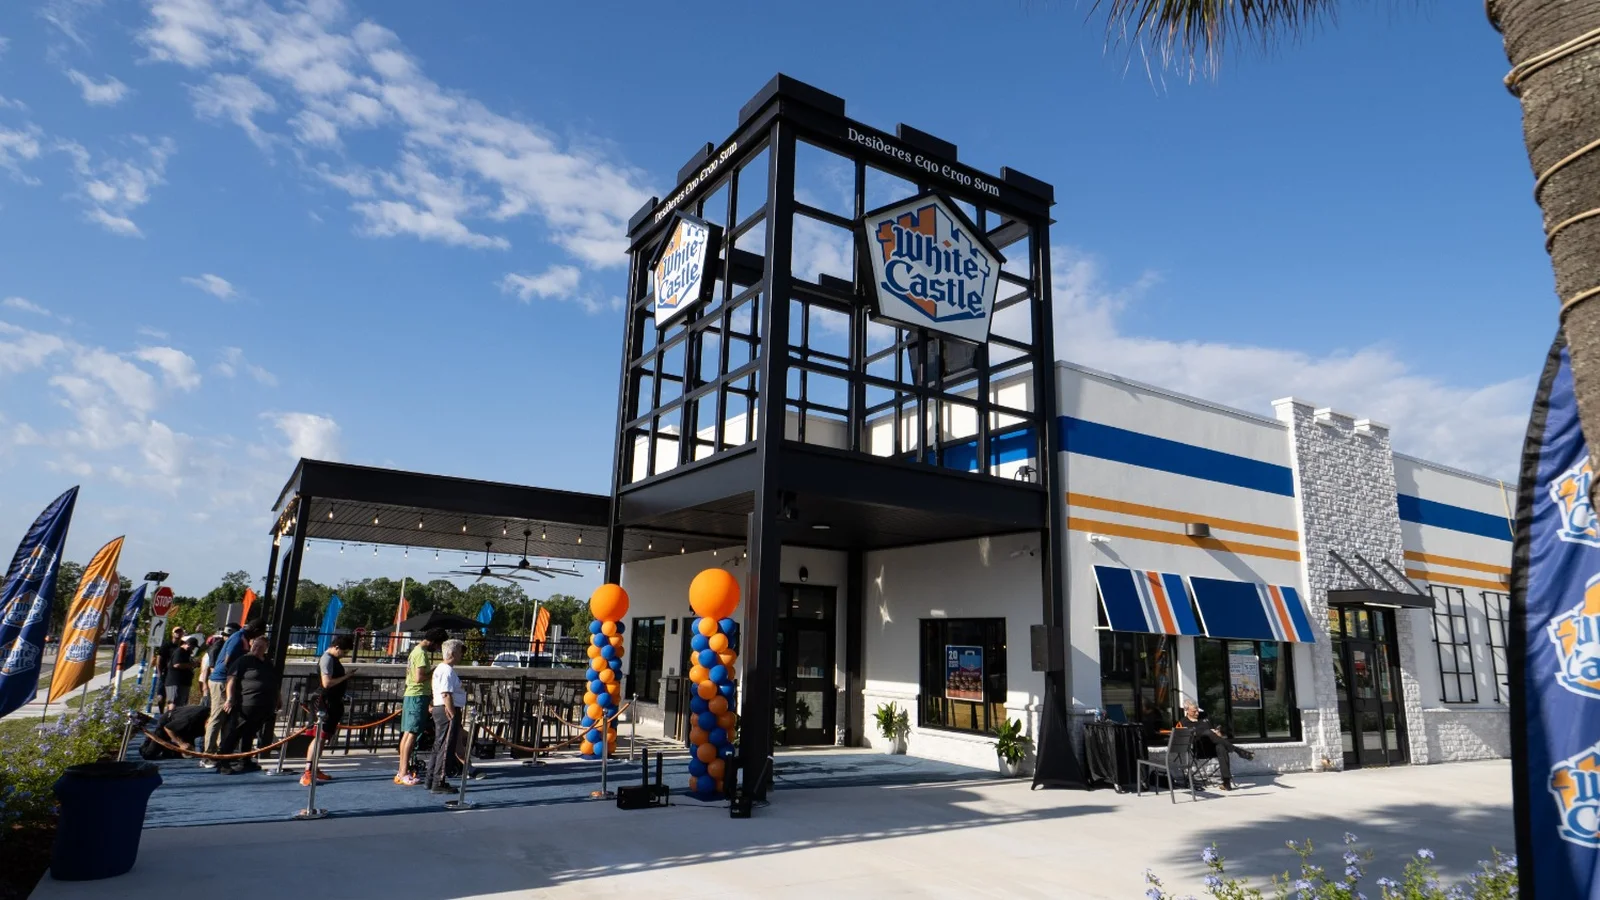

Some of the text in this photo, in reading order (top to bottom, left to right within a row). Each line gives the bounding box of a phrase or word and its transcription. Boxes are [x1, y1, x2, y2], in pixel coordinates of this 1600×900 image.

[848, 127, 912, 163] Desideres
[663, 239, 698, 280] White
[892, 225, 978, 280] White
[659, 263, 699, 304] Castle
[885, 259, 982, 314] Castle
[6, 612, 40, 622] Casle
[155, 595, 172, 607] STOP
[948, 650, 958, 660] 20
